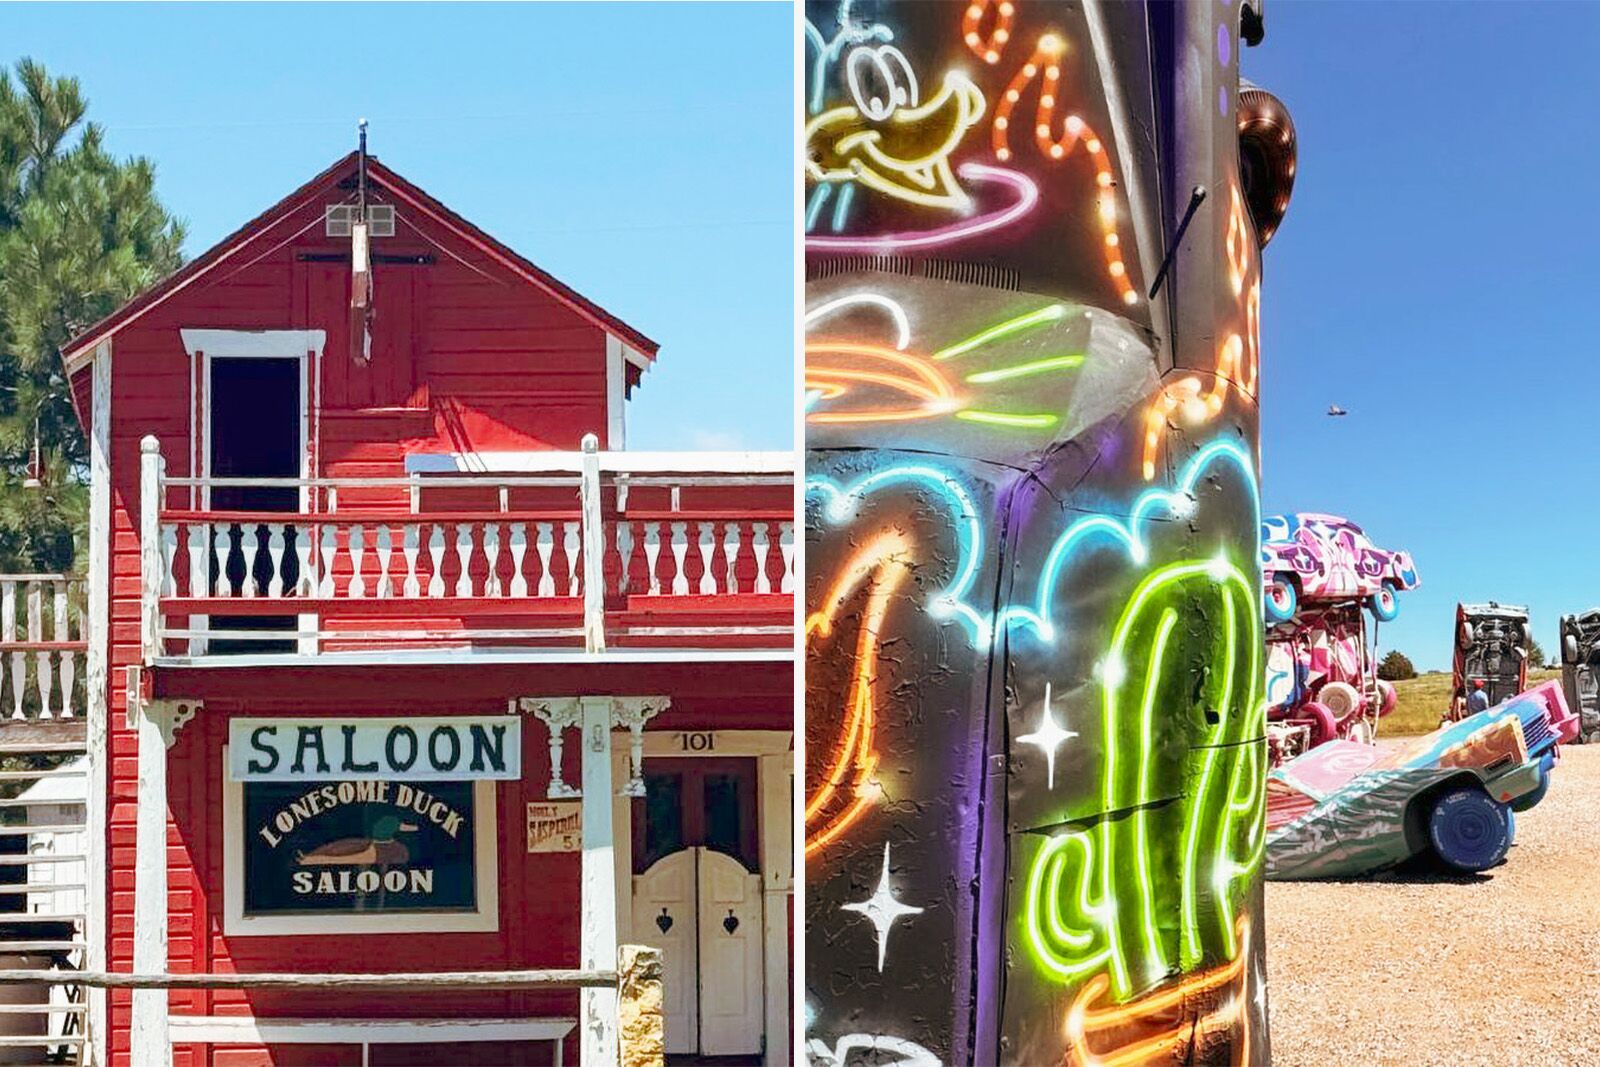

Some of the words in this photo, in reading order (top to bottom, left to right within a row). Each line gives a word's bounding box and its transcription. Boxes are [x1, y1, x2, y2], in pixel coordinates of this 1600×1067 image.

[247, 725, 507, 775] SALOON
[682, 733, 715, 751] 101
[259, 780, 390, 848] LONESOME
[395, 784, 464, 839] DUCK
[293, 868, 434, 894] SALOON
